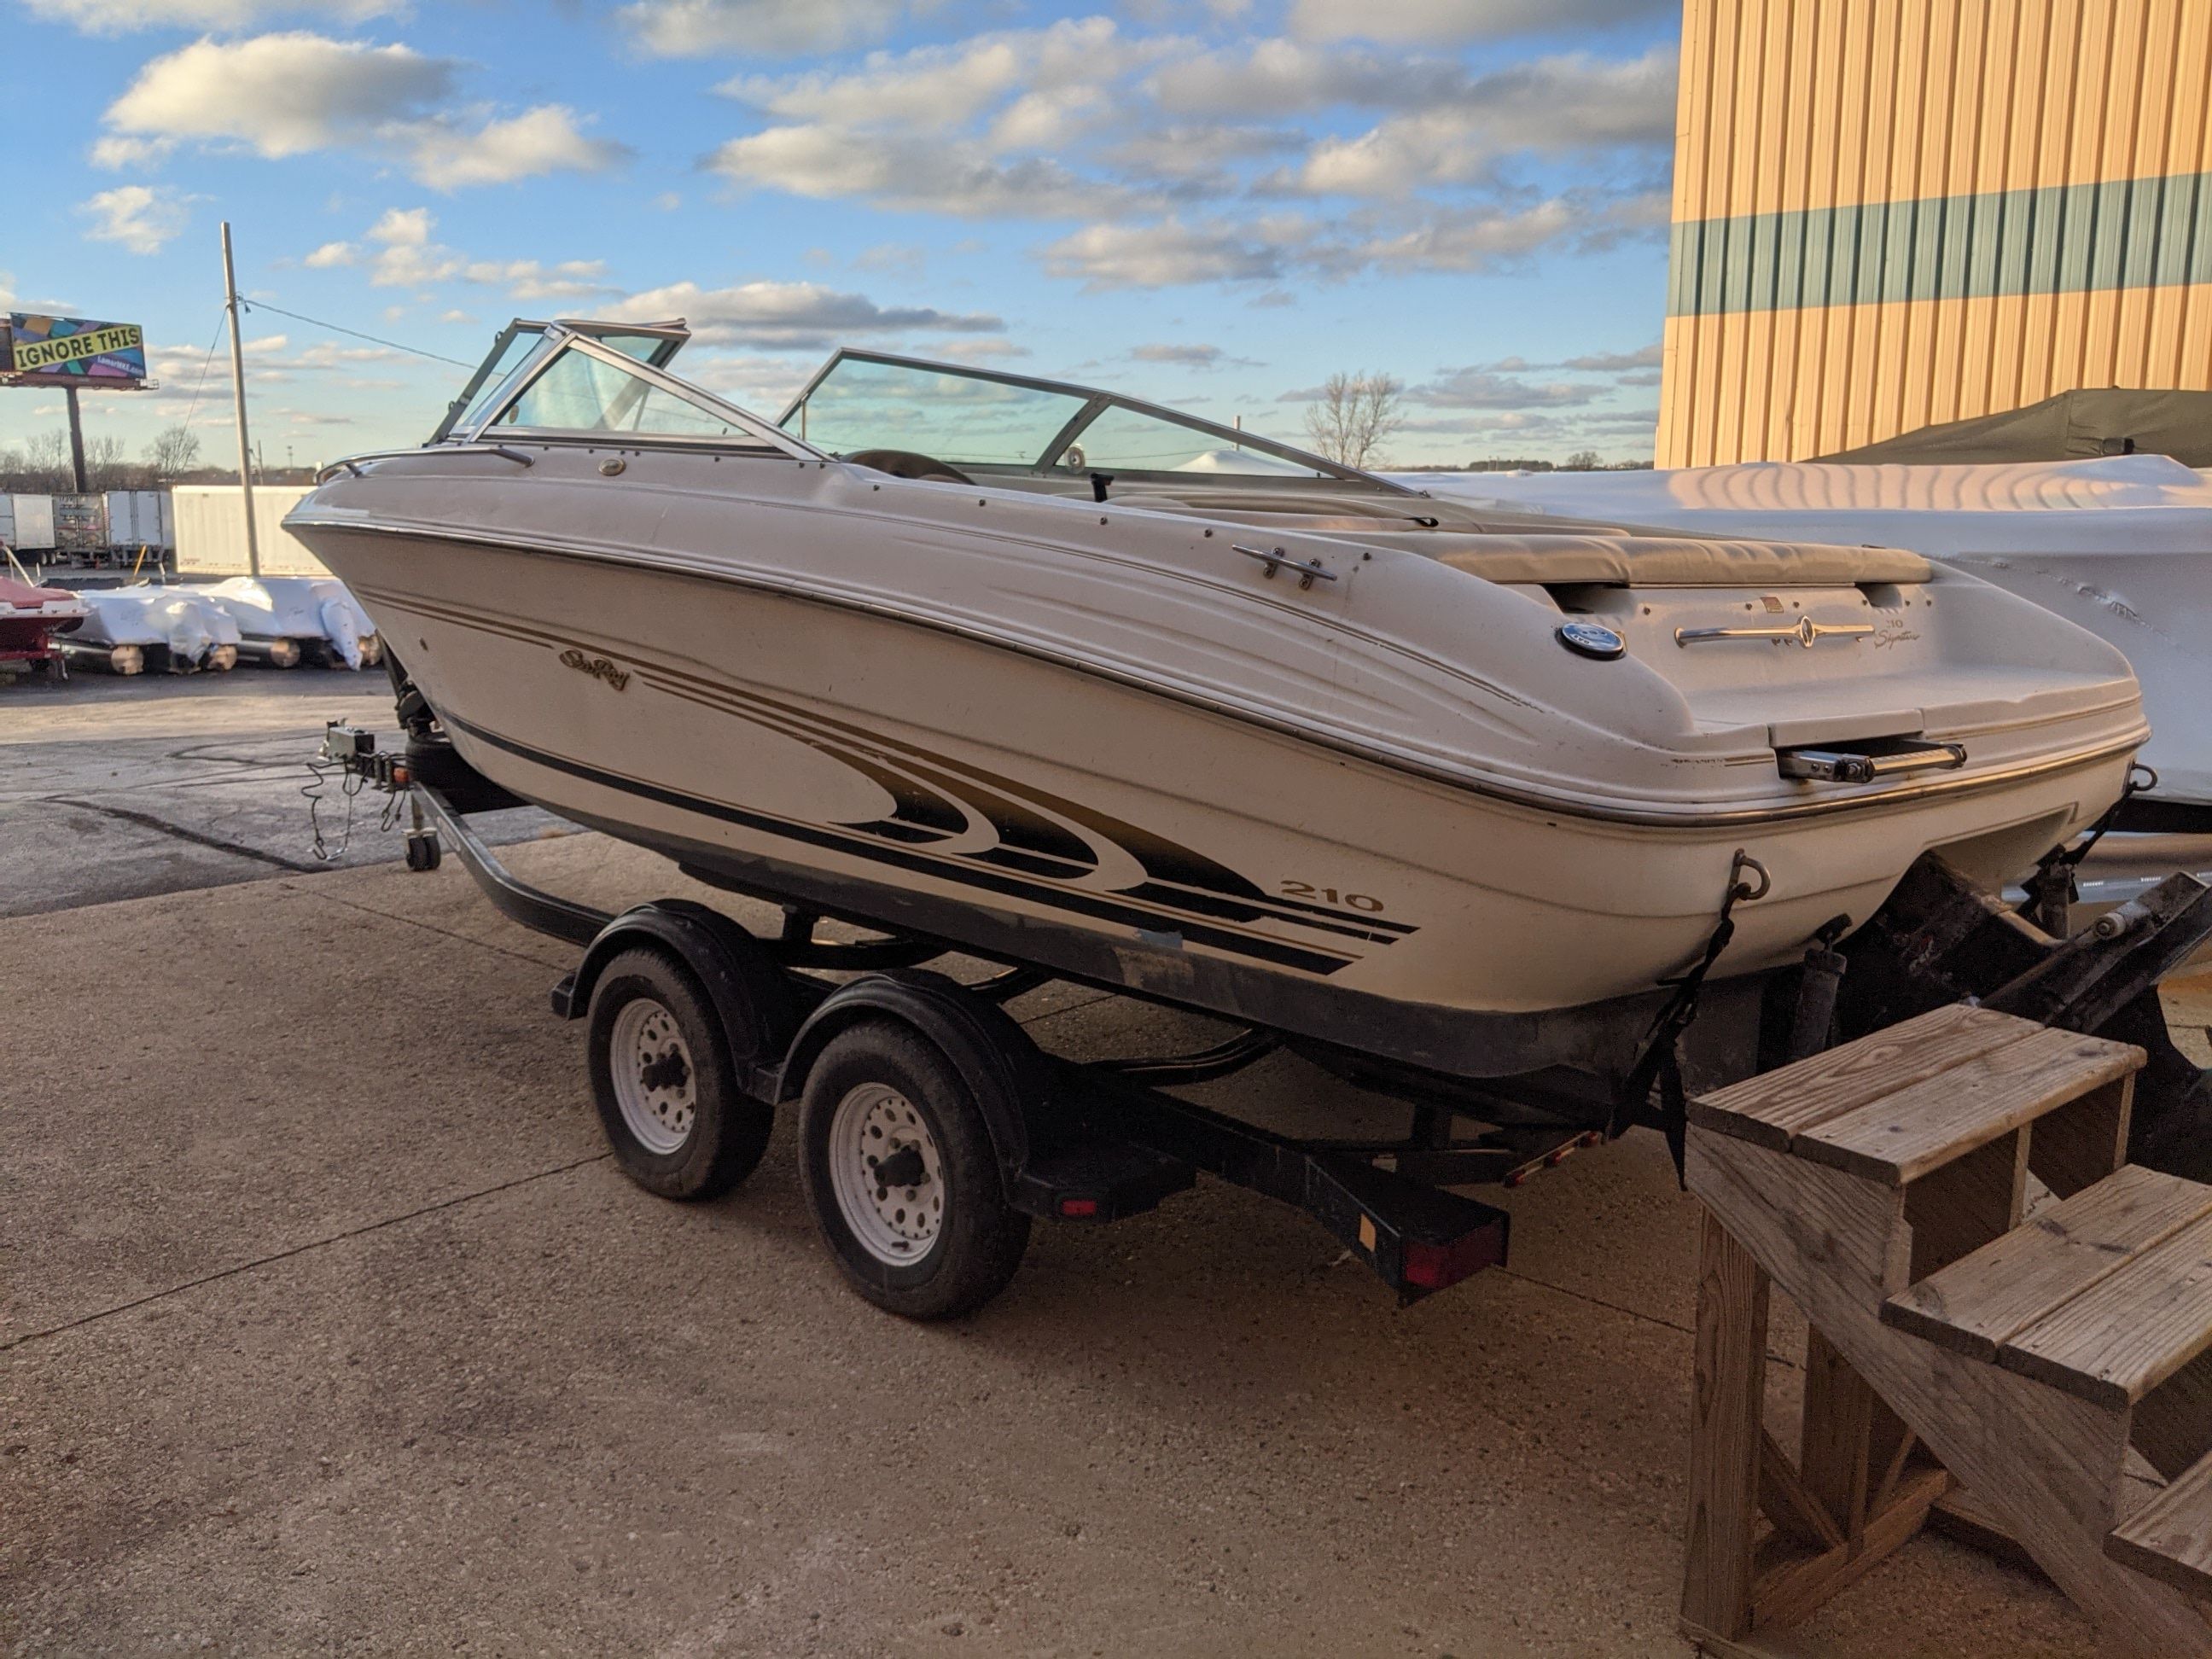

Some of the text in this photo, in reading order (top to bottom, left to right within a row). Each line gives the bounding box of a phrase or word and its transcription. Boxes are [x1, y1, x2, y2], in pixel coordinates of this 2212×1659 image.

[16, 328, 140, 368] IGNORE THIS
[1280, 880, 1384, 912] 210
